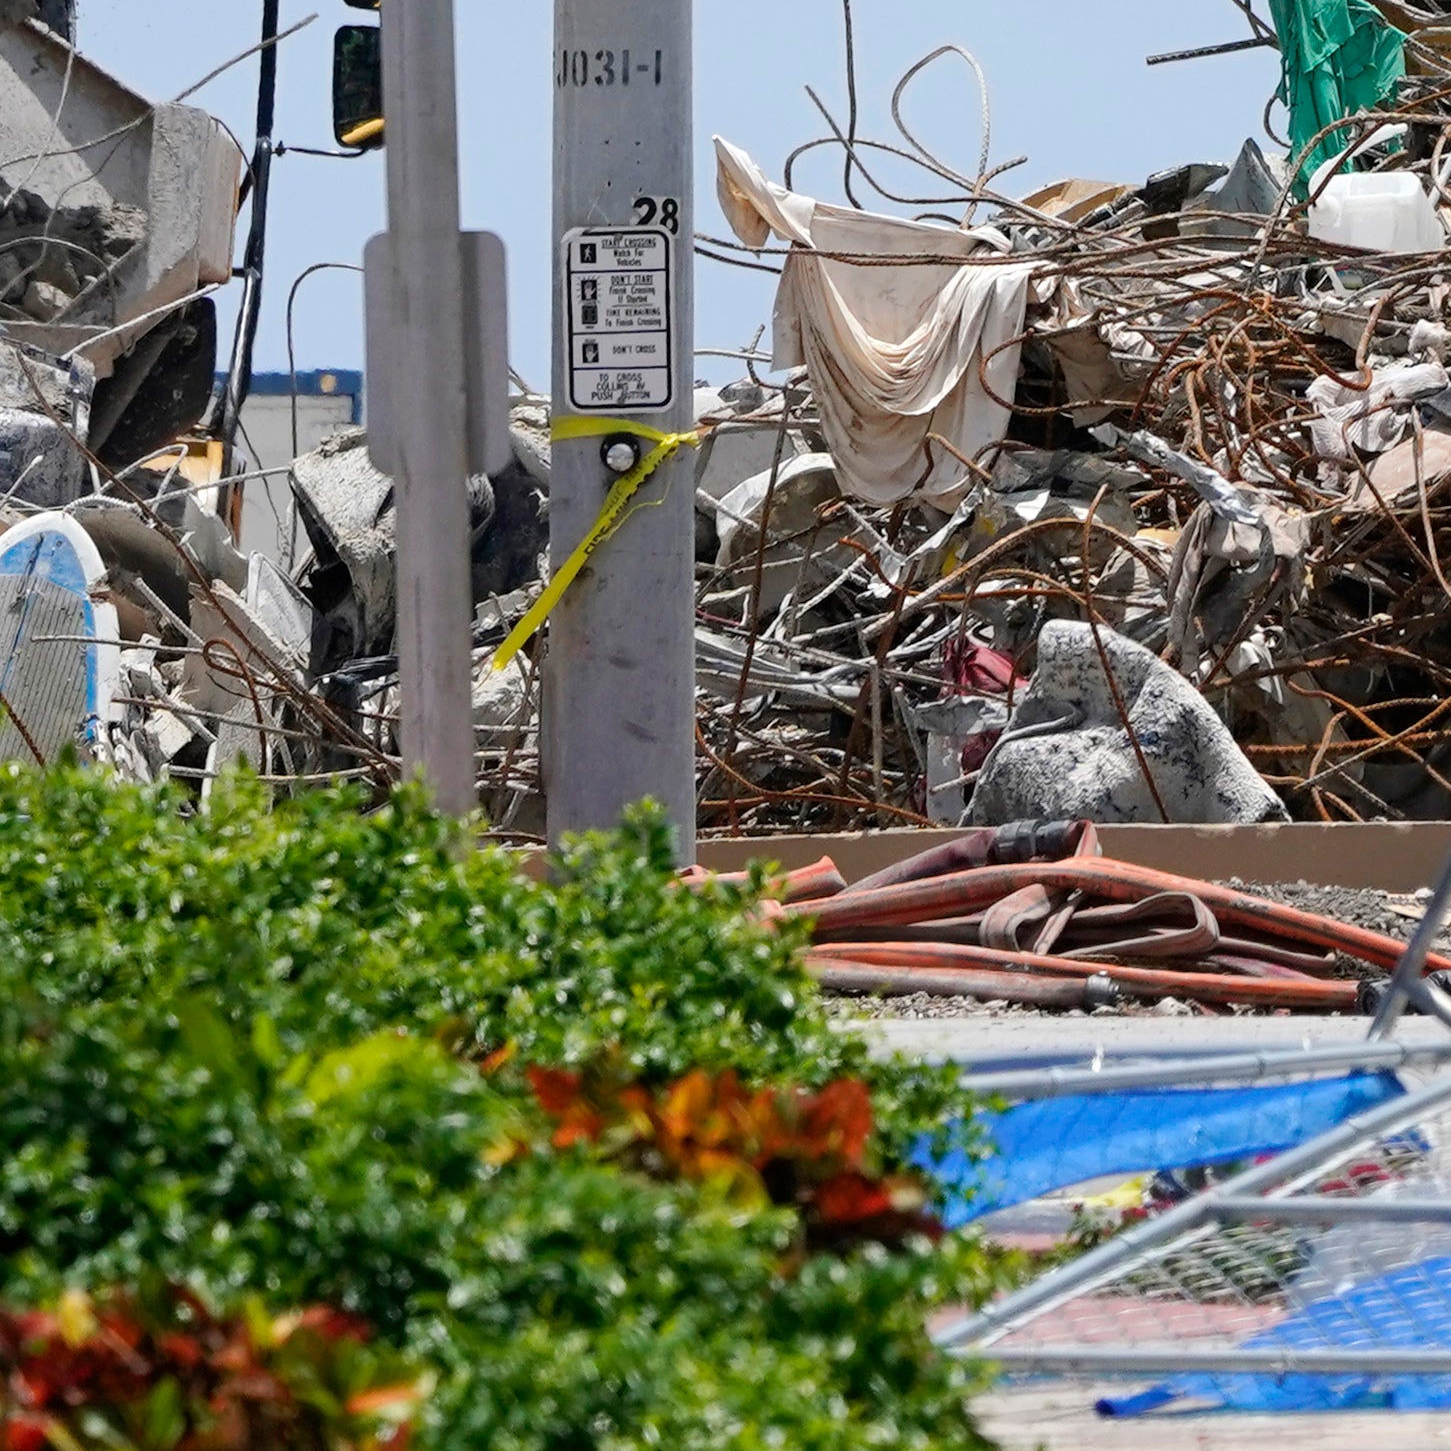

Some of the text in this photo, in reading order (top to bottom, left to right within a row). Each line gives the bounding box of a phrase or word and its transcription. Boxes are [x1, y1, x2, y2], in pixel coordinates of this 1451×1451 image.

[601, 237, 657, 249] START CROSSING
[633, 274, 654, 285] START
[599, 372, 643, 382] TO CROSS
[591, 391, 614, 401] PUSH
